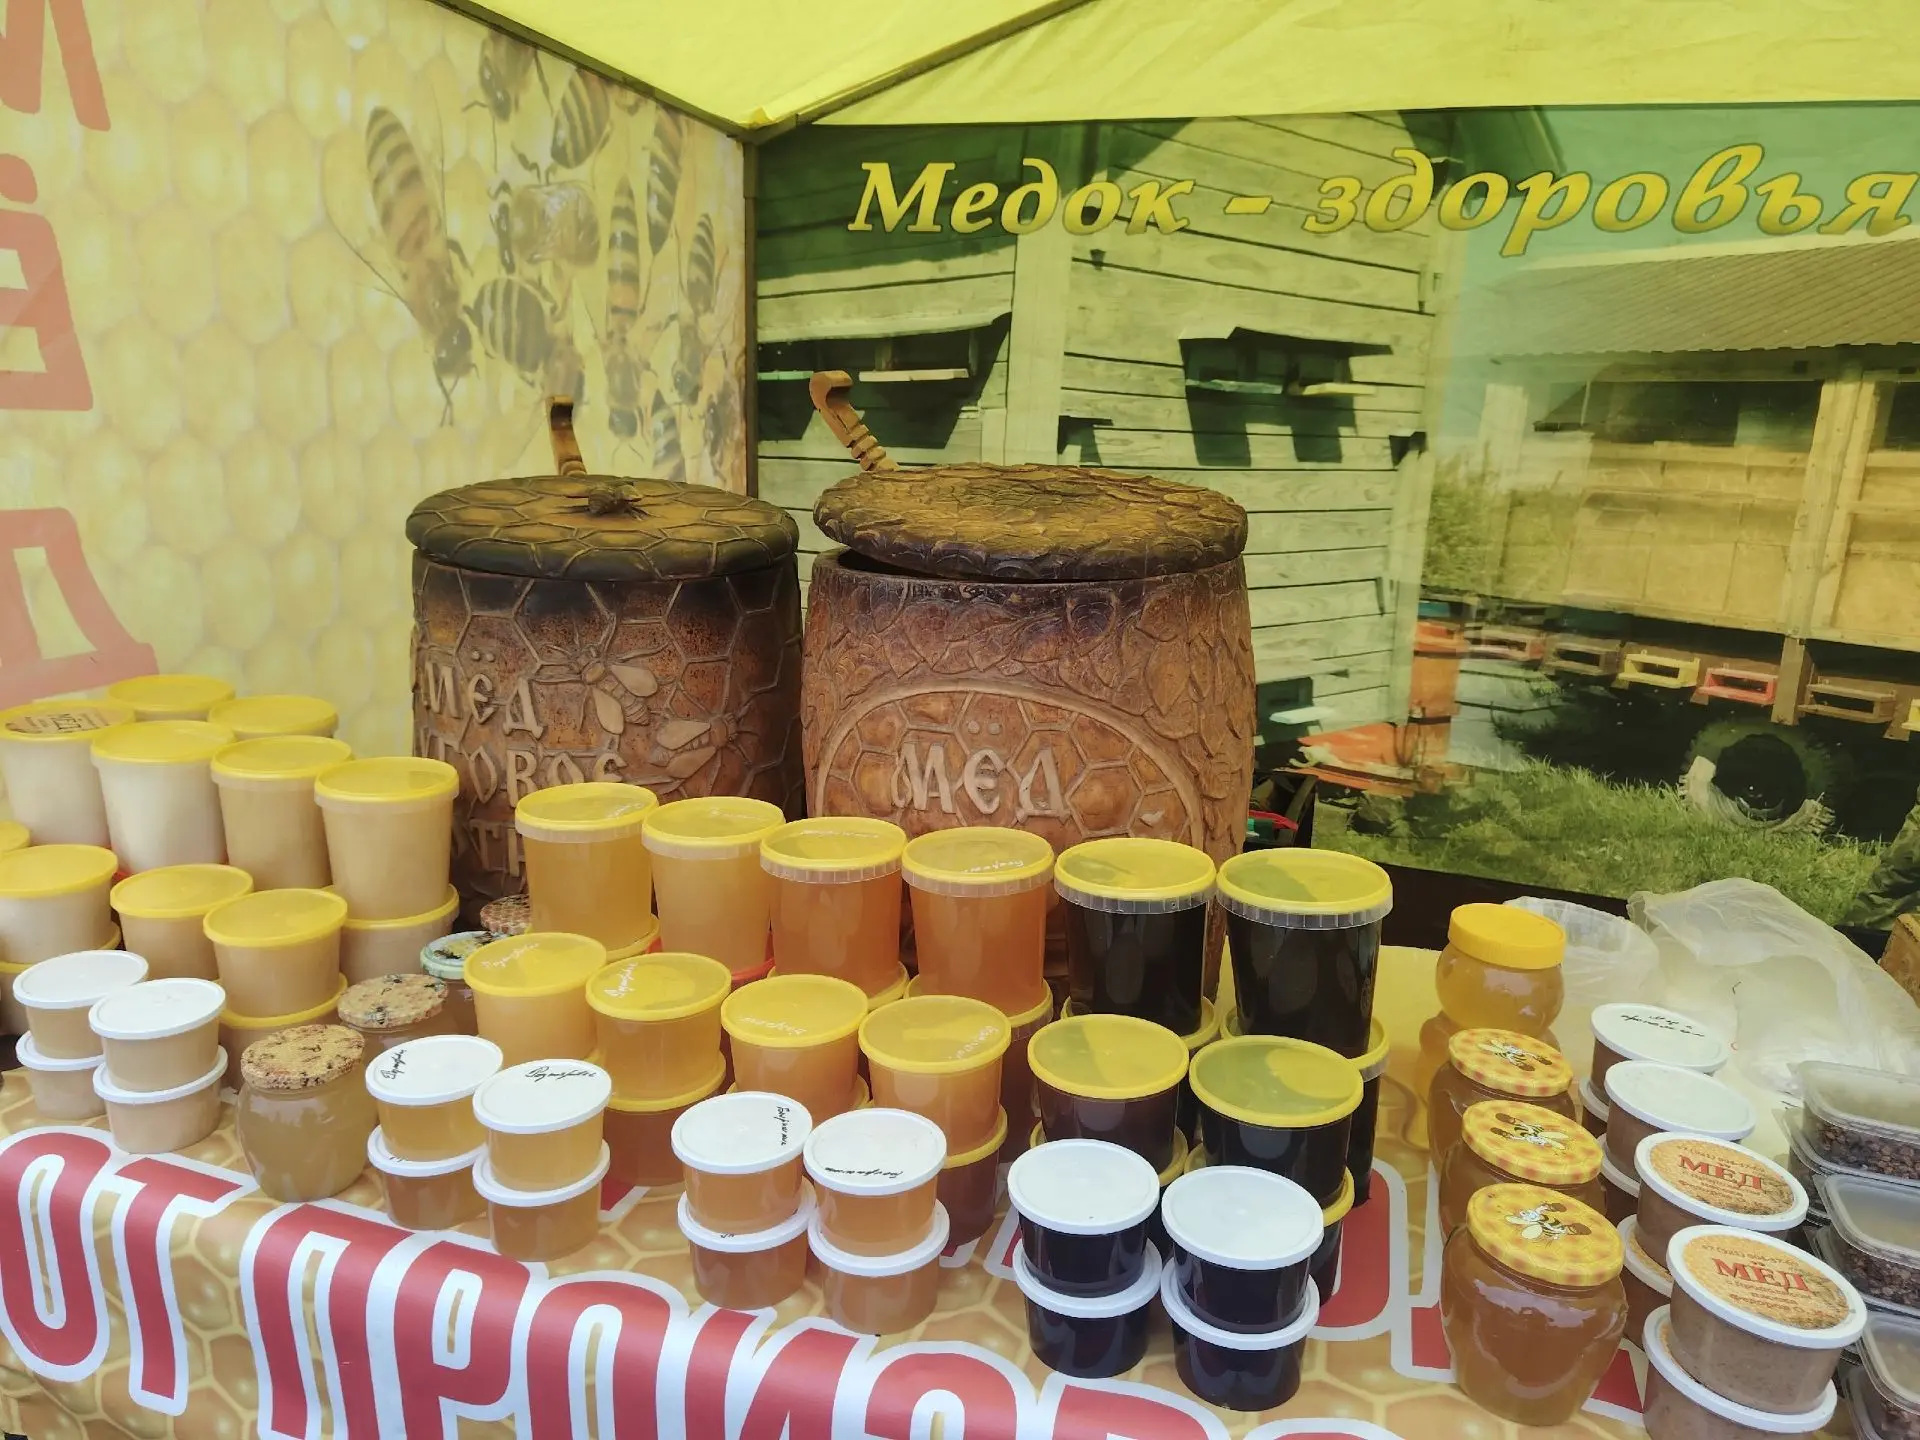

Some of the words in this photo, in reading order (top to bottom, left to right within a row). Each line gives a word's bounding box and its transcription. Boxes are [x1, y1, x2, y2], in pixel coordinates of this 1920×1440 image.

[846, 157, 1197, 236] Медок
[1224, 195, 1273, 215] -
[1302, 142, 1920, 258] здоровья
[1678, 1154, 1767, 1194] МЁД
[0, 1130, 244, 1401] ОТ
[1711, 1258, 1812, 1295] МЁД
